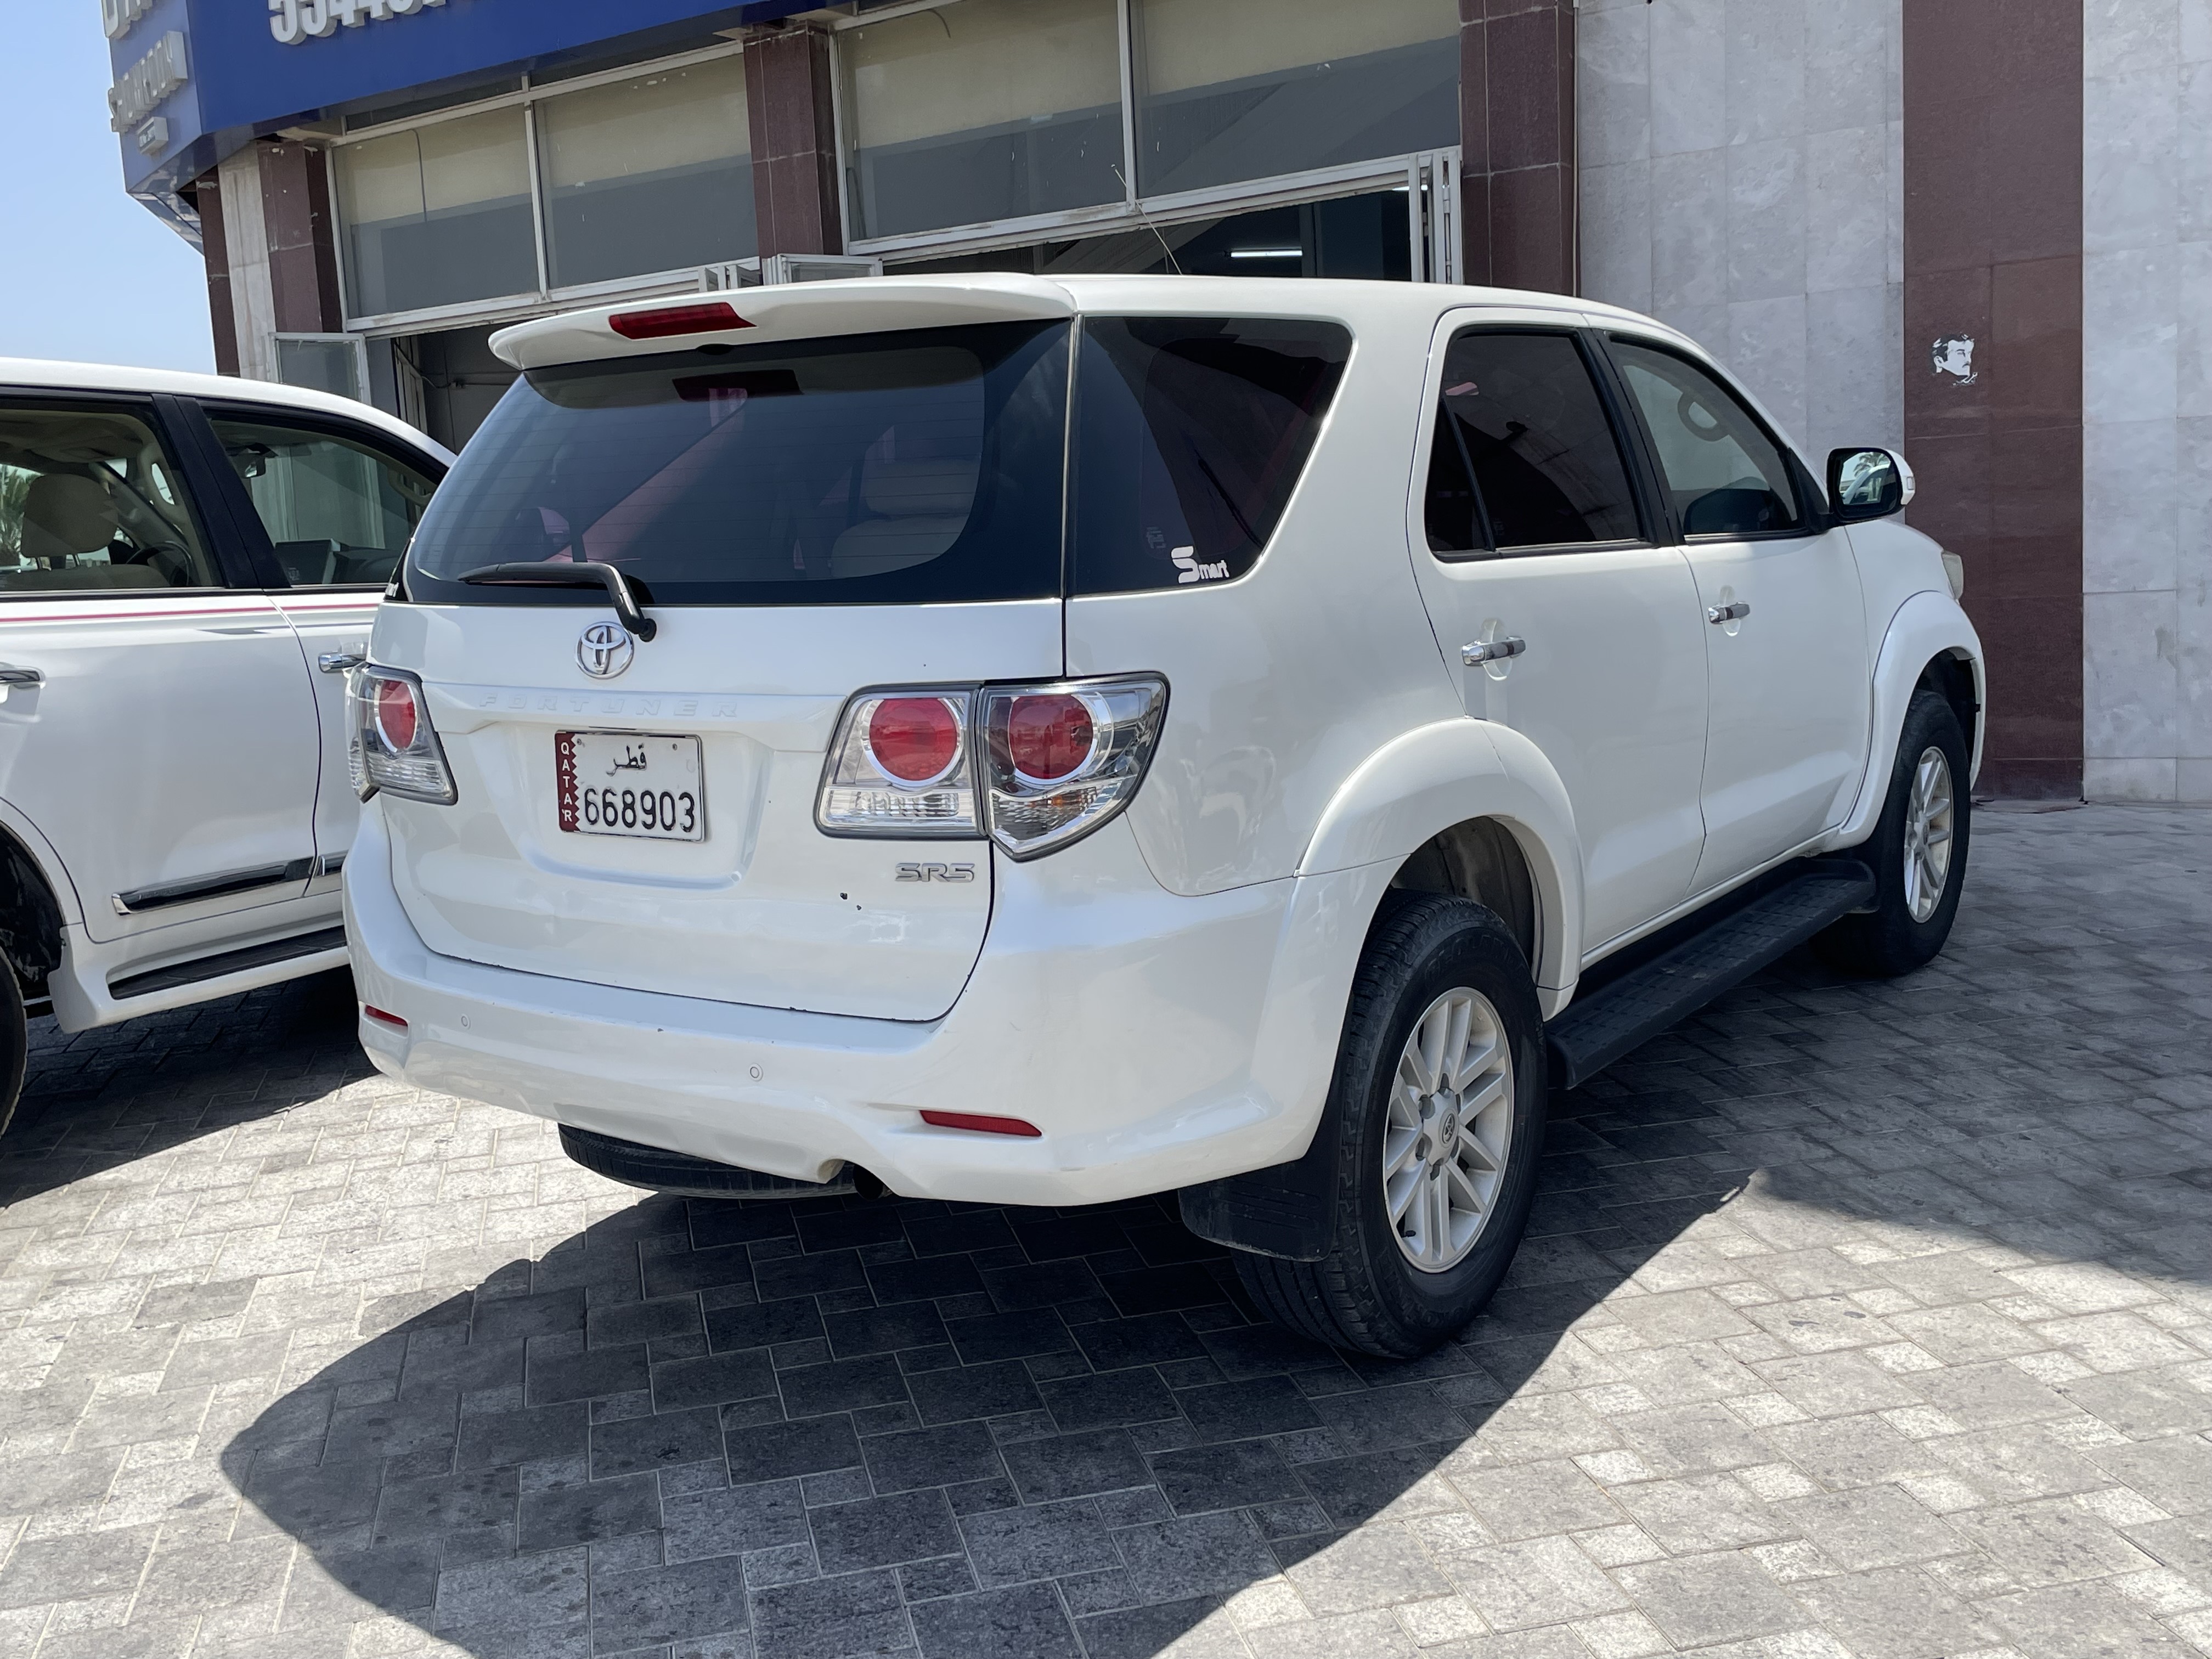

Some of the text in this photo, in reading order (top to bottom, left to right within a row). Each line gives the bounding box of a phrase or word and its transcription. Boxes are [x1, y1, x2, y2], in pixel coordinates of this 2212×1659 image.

[479, 692, 738, 718] FORTUNER
[606, 743, 647, 777] قطر
[560, 742, 573, 822] QATAR
[584, 788, 696, 833] 668903
[895, 862, 975, 883] SR5
